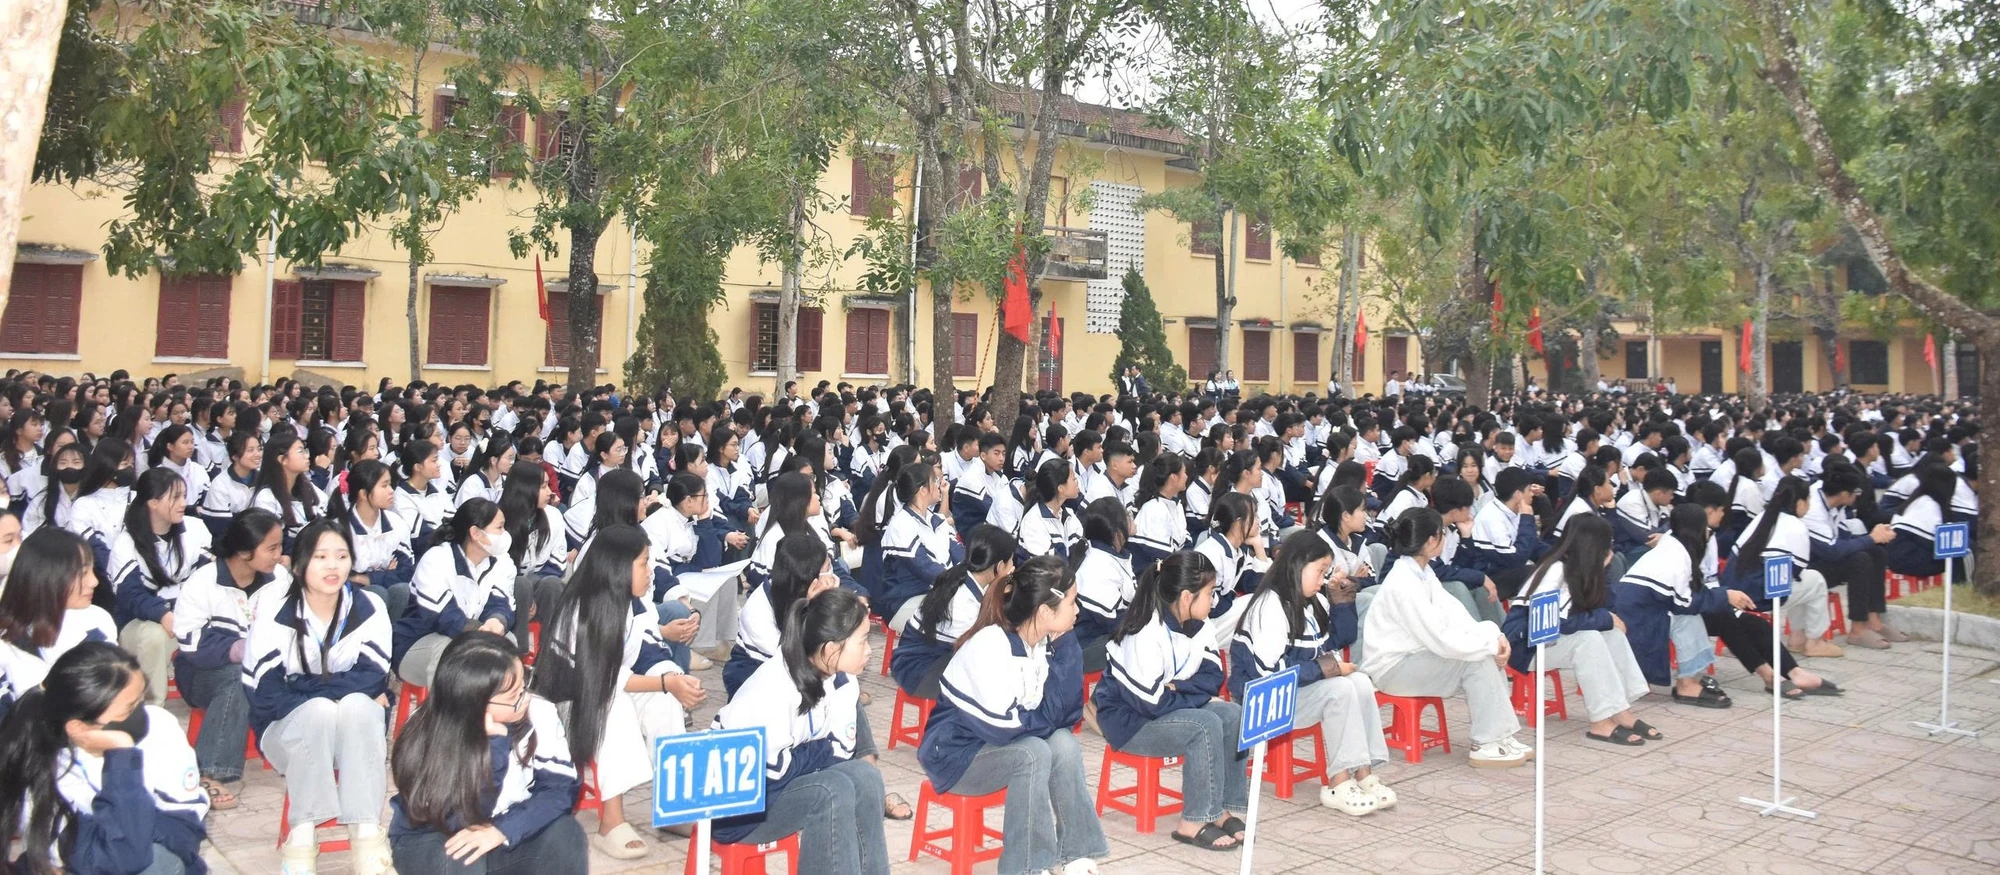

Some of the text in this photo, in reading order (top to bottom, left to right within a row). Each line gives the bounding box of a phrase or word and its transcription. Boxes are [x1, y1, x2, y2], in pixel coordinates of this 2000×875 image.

[1939, 531, 1950, 549] 11
[1769, 564, 1779, 587] 11
[1532, 601, 1558, 633] 11 A10
[1248, 682, 1293, 731] 11 A11
[663, 745, 757, 802] 11 A12
